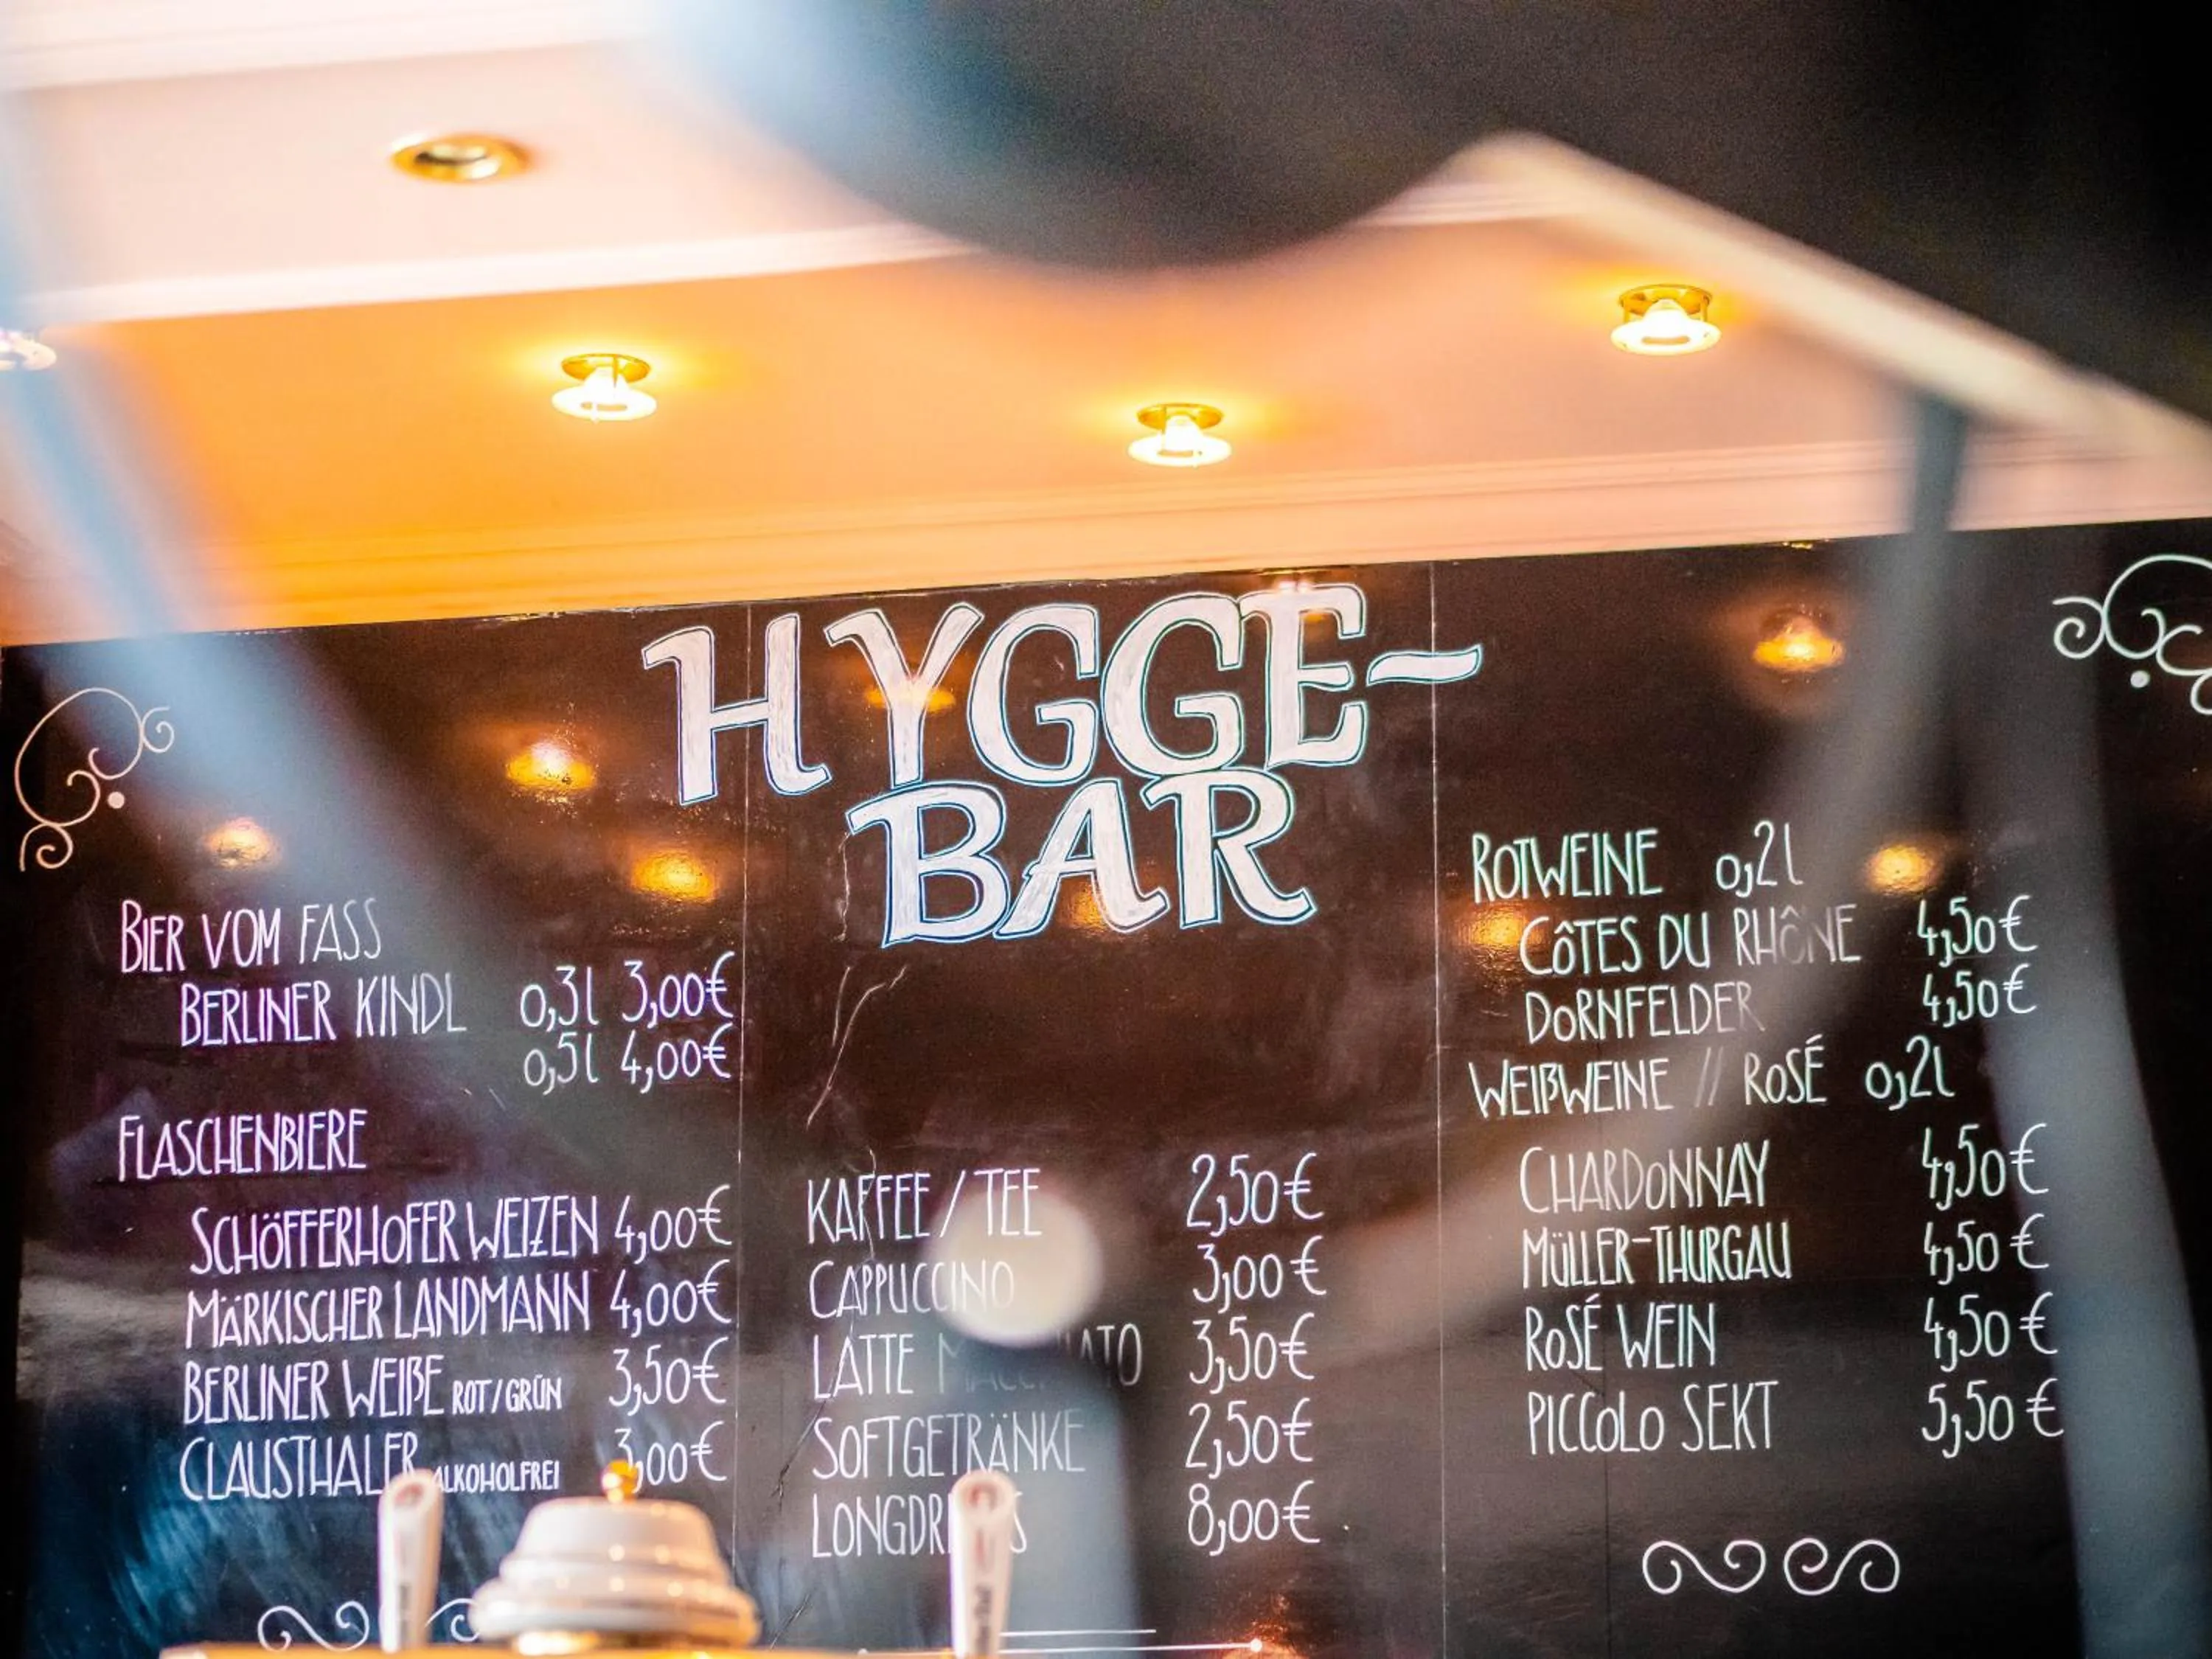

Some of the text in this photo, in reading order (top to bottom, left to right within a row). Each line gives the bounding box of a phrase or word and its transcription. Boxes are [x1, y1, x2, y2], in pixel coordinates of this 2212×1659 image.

[846, 765, 1316, 948] BAR
[1472, 827, 1663, 904] ROTWEINE
[120, 897, 383, 974] BIER VOM FASS
[1520, 916, 1642, 977] CÔTES
[1659, 913, 1711, 970] DU
[1733, 903, 1862, 967] RHÔNE
[180, 979, 337, 1047] BERLINER
[355, 971, 467, 1039] KINDL
[622, 951, 735, 1028] 3,00€
[1526, 981, 1766, 1046] DORNFELDER
[621, 1022, 733, 1094] 4,00€
[1744, 1034, 1826, 1107] ROSÉ
[118, 1109, 368, 1181] FLASCHENBIERE
[1519, 1139, 1771, 1214] CHARDONNAY
[189, 1185, 732, 1275] SCHÖFFERHOFER WEIZEN 4,00€
[807, 1172, 931, 1244] KAFFEE
[973, 1167, 1043, 1237] TEE
[1186, 1152, 1324, 1237] 2,50€
[809, 1260, 1016, 1319] CAPPUCCINO
[1522, 1221, 1792, 1290] MÜLLER-THURGAU
[184, 1259, 732, 1349] MÄRKISCHER LANDMANN 4,00€
[1525, 1293, 1603, 1372] ROSÉ
[1616, 1302, 1717, 1370] WEIN
[184, 1360, 331, 1426] BERLINER
[608, 1337, 729, 1416] 3,50€
[813, 1332, 914, 1400] LATTE
[1189, 1312, 1315, 1394] 3,50€
[813, 1397, 1315, 1480] SOFTGETRÄNKE 2,50€
[1528, 1390, 1666, 1455] PICCOLO
[1681, 1380, 1779, 1452] SEKT
[178, 1430, 420, 1503] CLAUSTHALER
[431, 1461, 561, 1493] ALKOHOLFREI
[1187, 1480, 1321, 1557] 8,00€
